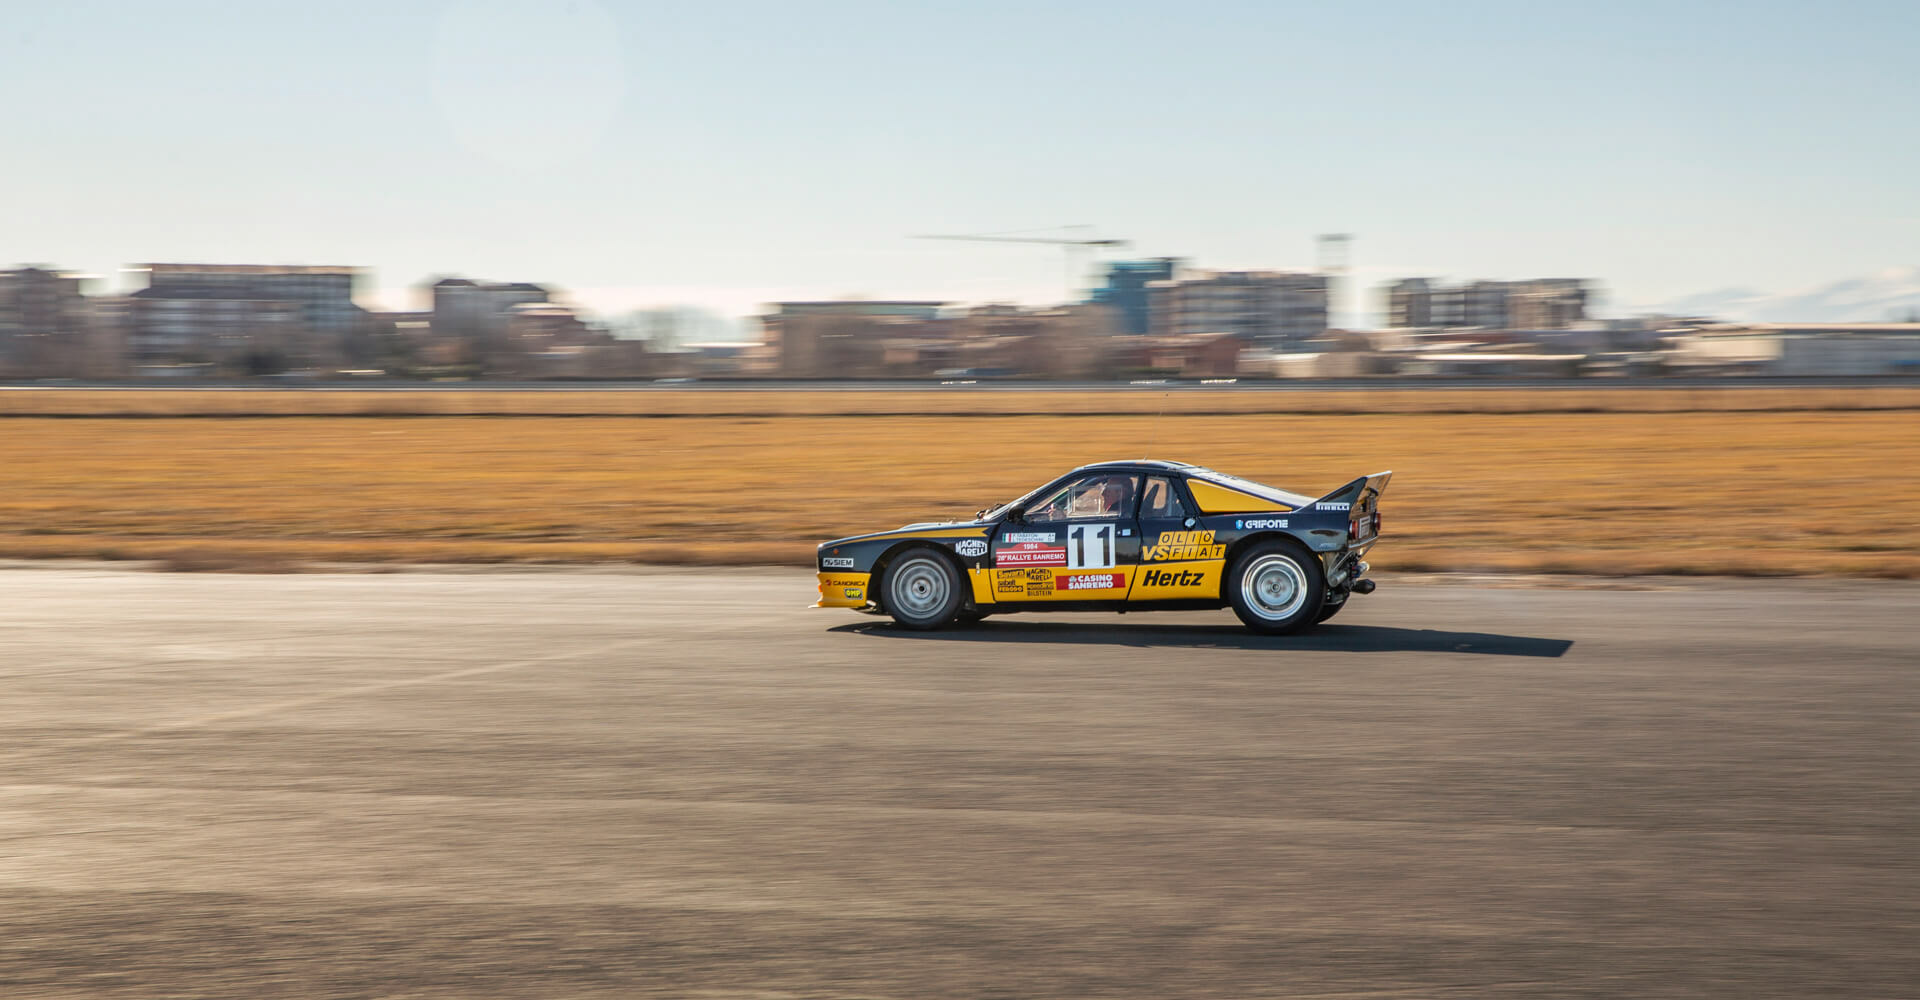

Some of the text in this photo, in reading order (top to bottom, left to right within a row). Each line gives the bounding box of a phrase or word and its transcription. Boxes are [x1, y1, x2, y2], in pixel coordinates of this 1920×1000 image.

[1245, 519, 1289, 529] GRIFONE
[1161, 533, 1212, 544] OLIO
[1071, 526, 1110, 567] 11
[1078, 574, 1113, 582] CASINO
[1143, 570, 1204, 586] Hertz
[1068, 581, 1114, 589] SANREMO
